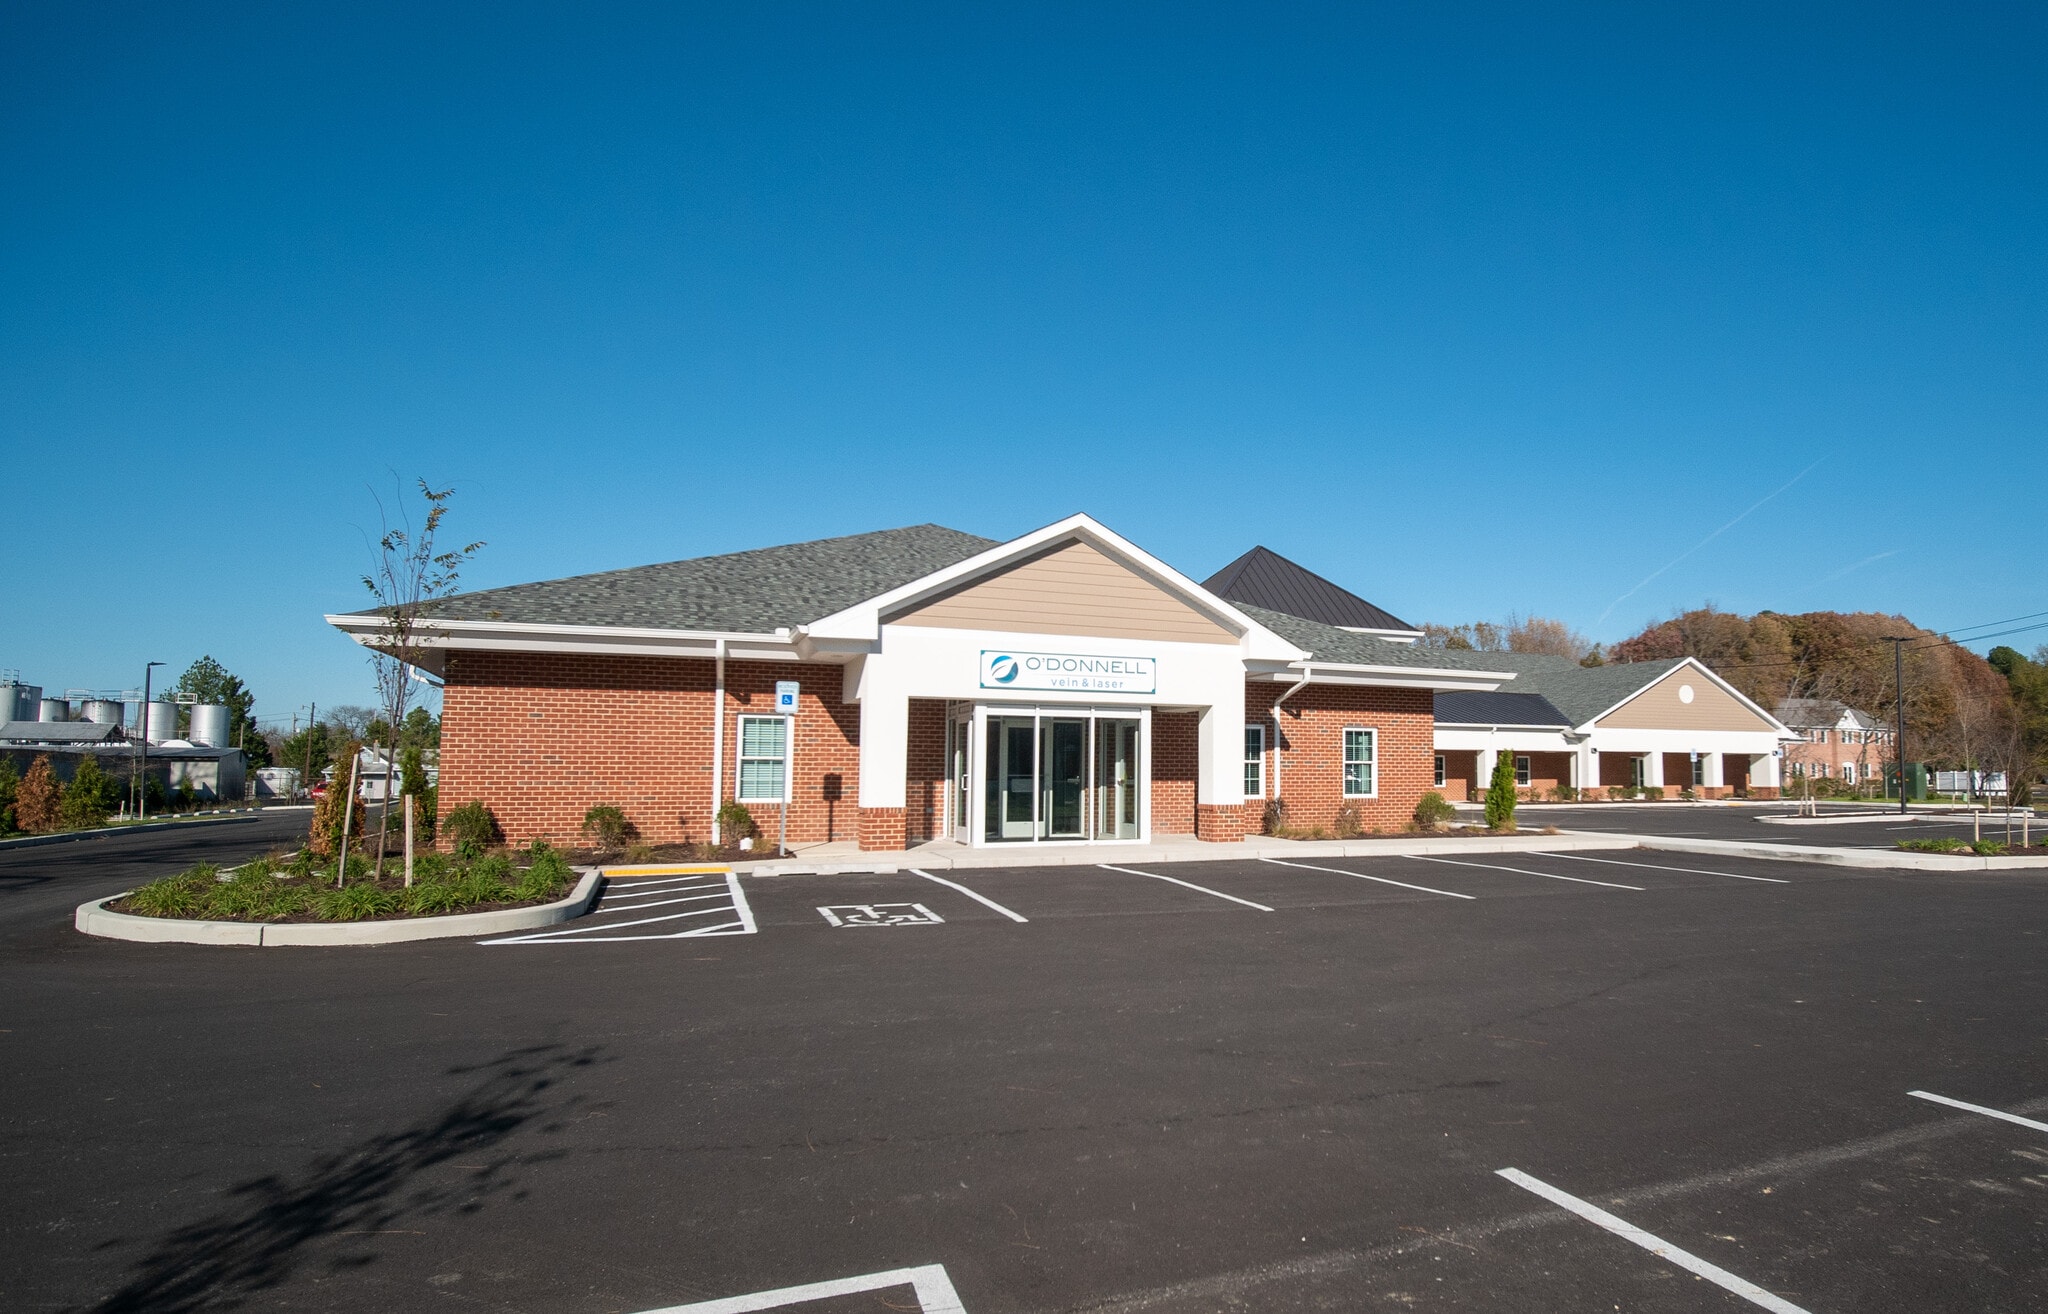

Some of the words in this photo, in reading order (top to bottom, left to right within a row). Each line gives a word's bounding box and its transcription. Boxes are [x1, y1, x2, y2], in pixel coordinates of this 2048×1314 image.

[1026, 657, 1147, 674] O'DONNELL
[1051, 678, 1079, 687] vein
[1082, 679, 1090, 688] &
[1092, 678, 1124, 689] laser
